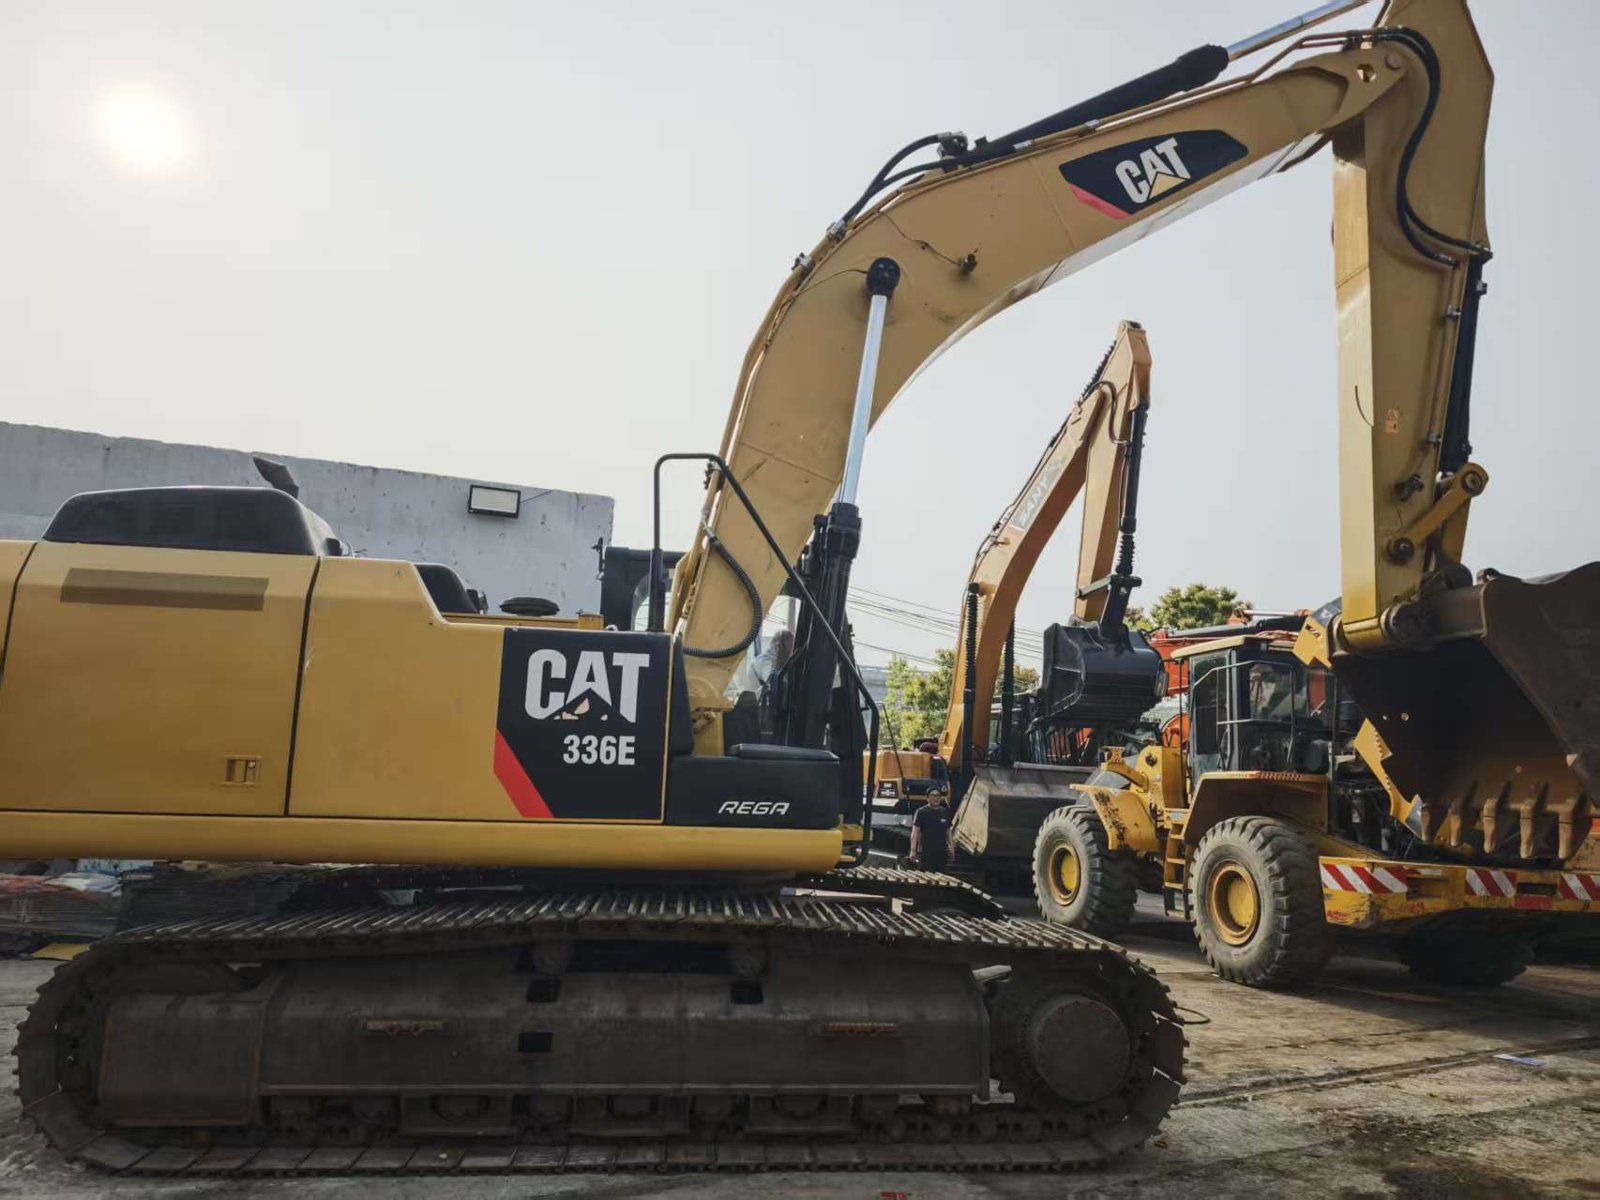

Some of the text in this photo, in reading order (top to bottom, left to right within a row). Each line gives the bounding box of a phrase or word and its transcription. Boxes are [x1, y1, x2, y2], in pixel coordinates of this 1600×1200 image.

[1115, 137, 1191, 204] CAT
[525, 649, 650, 723] CAT
[563, 734, 636, 766] 336E
[717, 801, 790, 815] REGA
